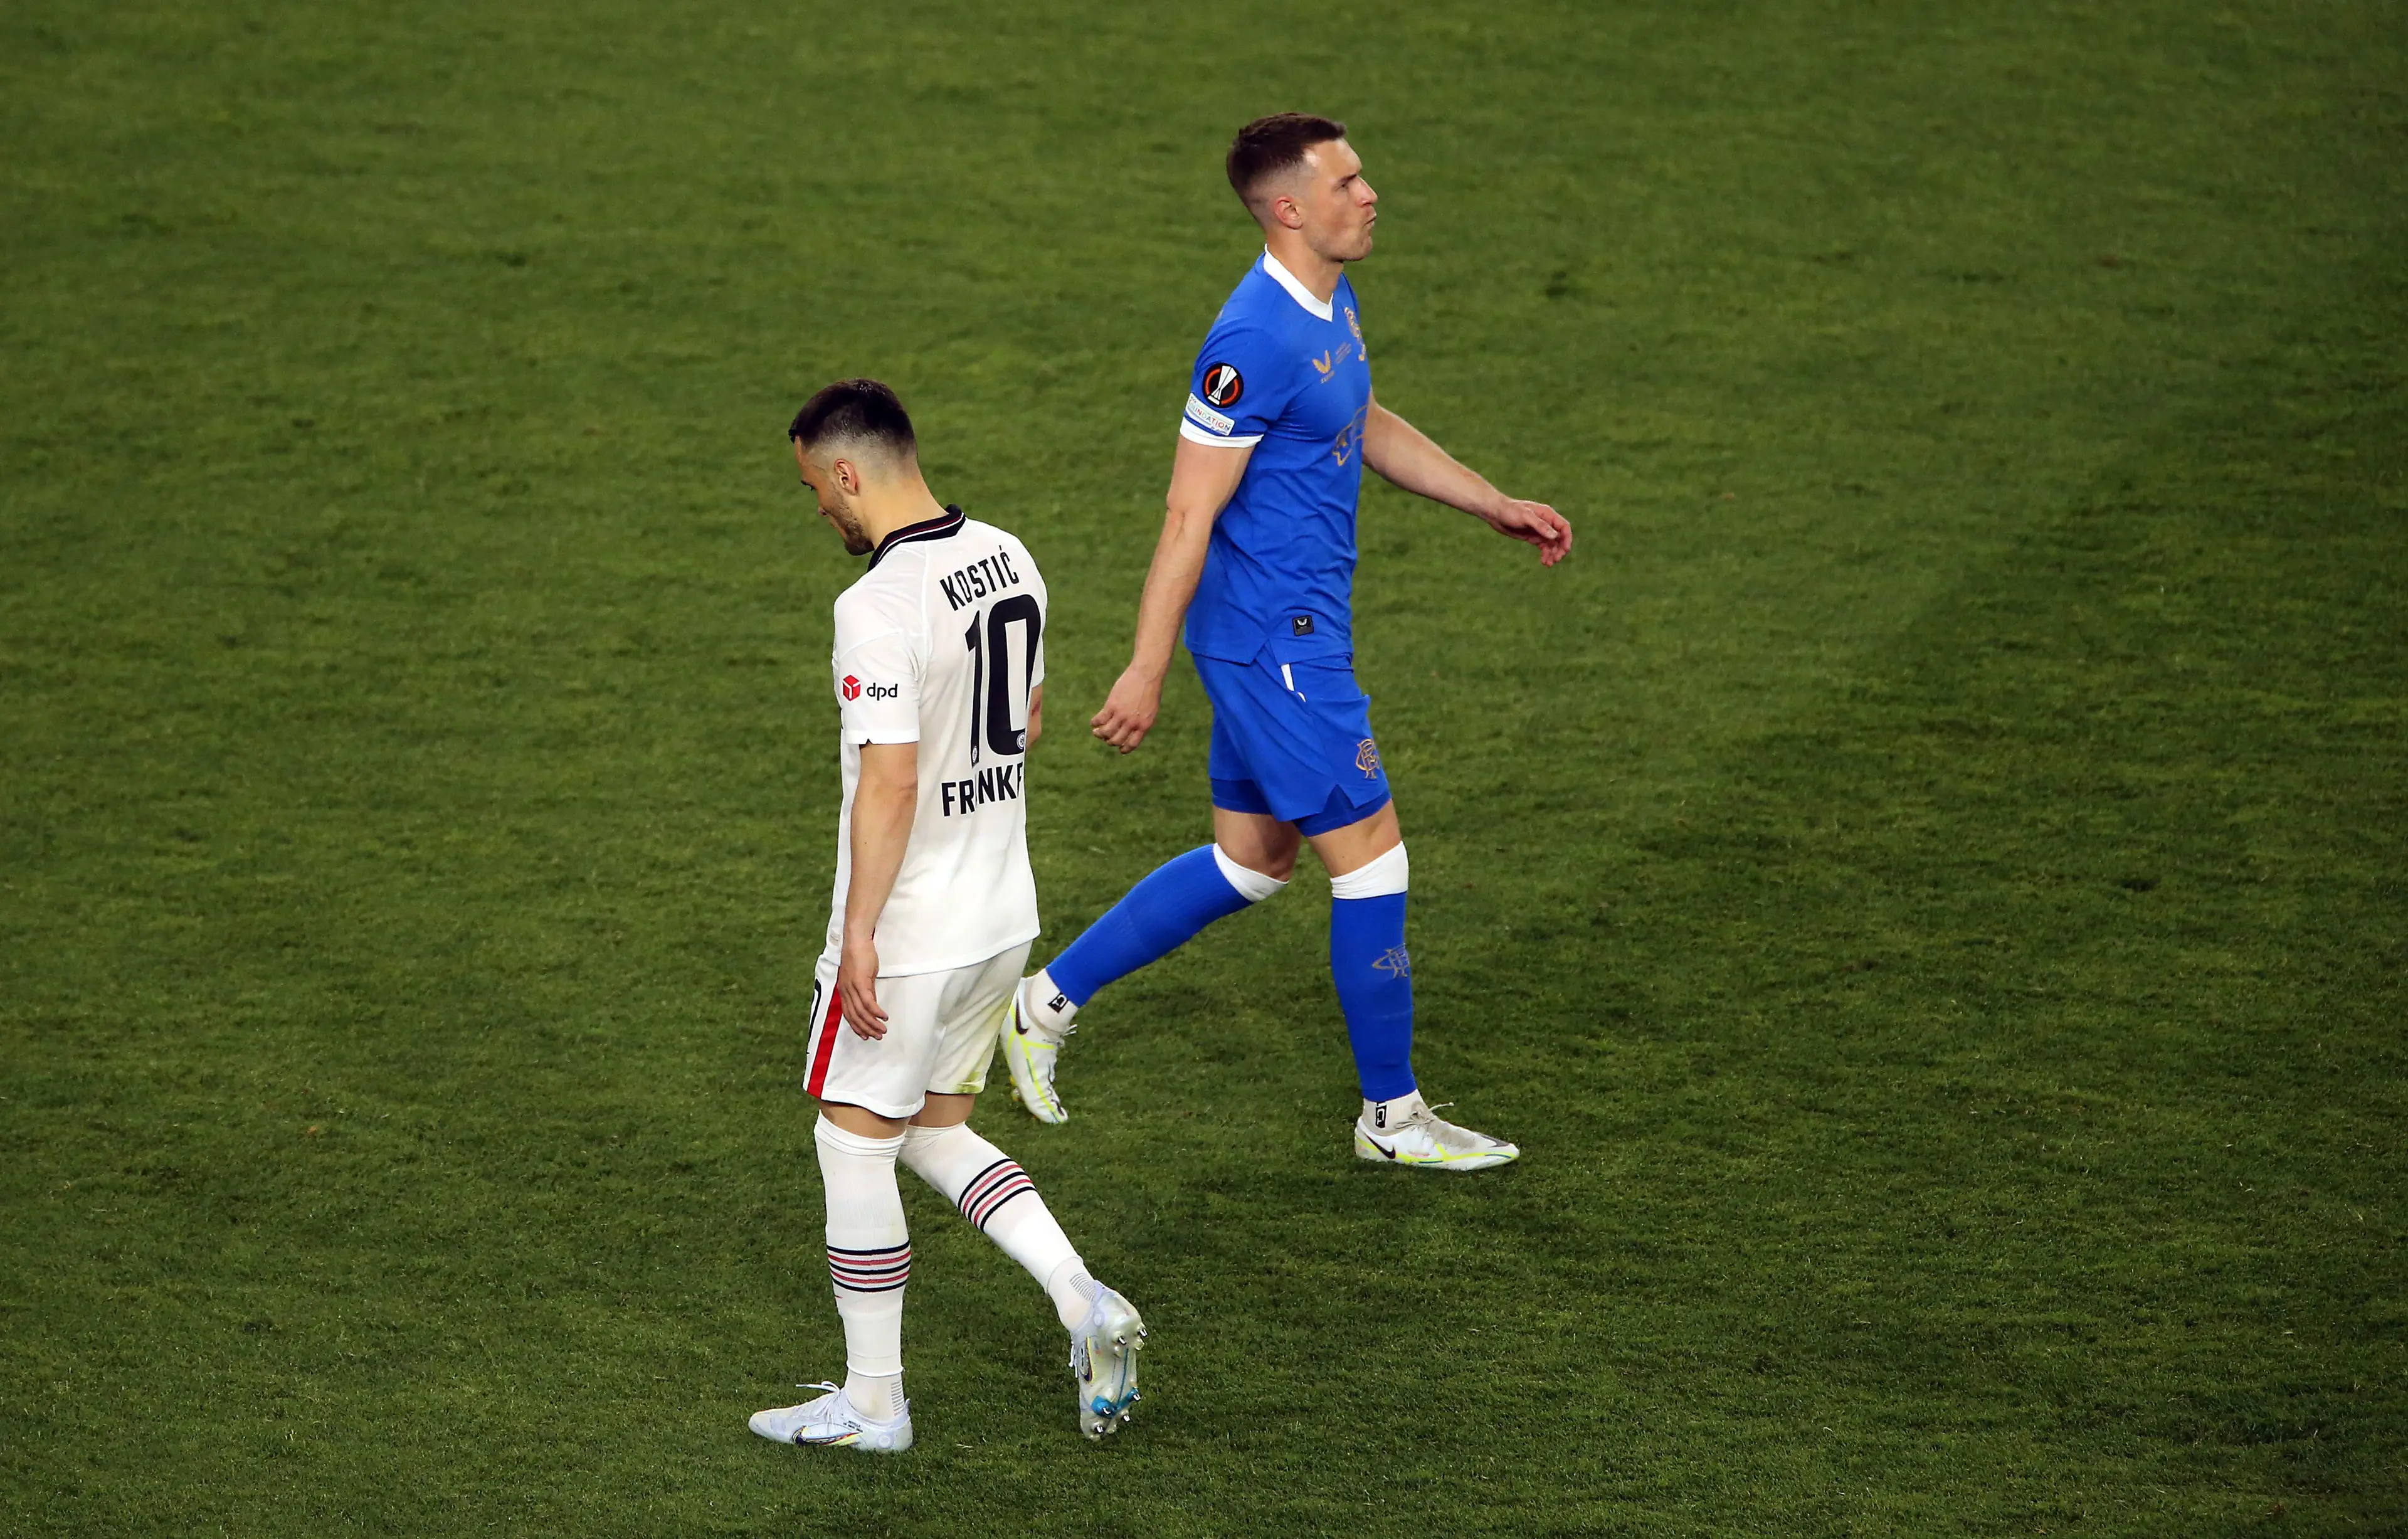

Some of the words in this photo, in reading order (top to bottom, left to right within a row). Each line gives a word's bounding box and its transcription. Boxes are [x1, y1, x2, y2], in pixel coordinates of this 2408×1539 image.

[939, 544, 1020, 611] KOSTIĆ
[867, 682, 898, 701] dpd
[964, 593, 1041, 769] 10
[941, 761, 1023, 817] FRNKF
